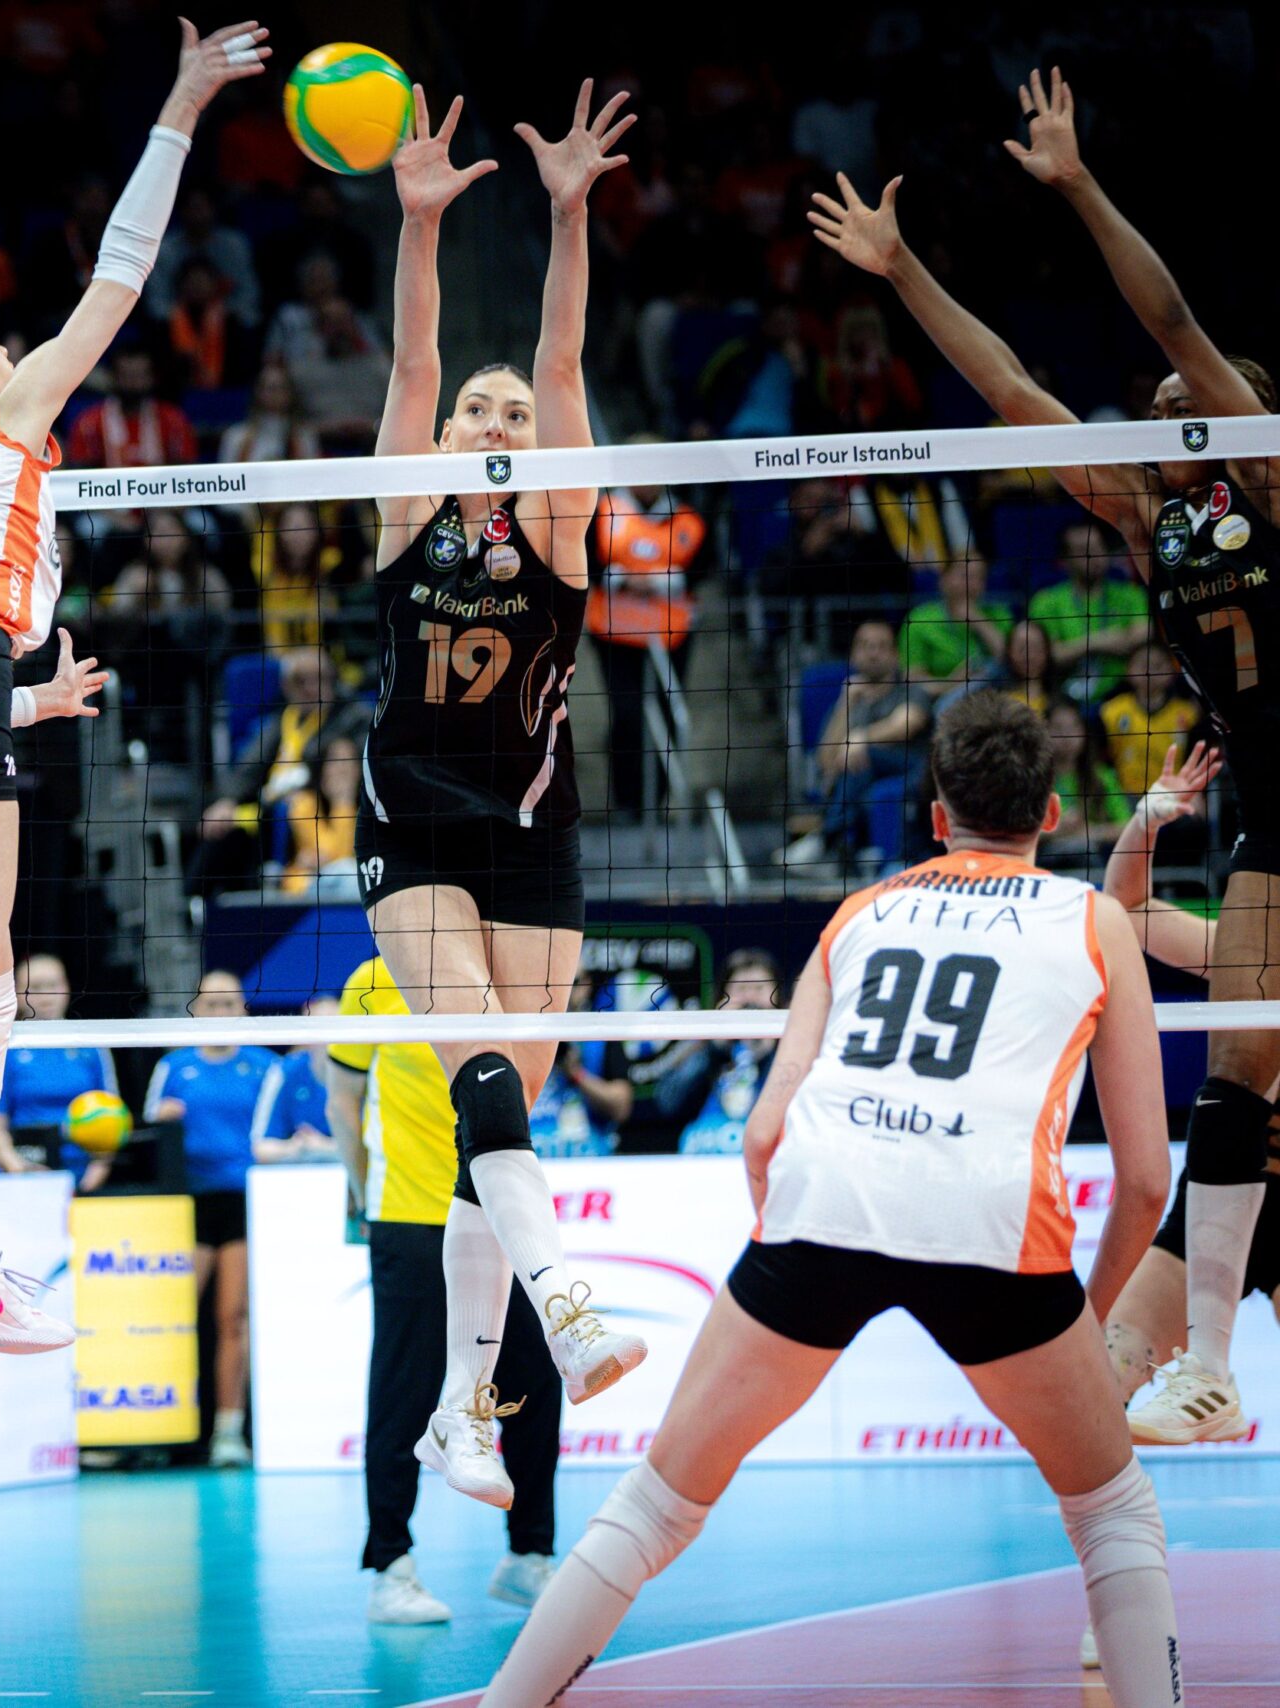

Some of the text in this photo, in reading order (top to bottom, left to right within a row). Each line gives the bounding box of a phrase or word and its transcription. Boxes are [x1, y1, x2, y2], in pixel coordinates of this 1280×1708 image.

[755, 441, 931, 468] Final Four Istanbul
[78, 474, 246, 498] Final Four Istanbul
[418, 620, 512, 704] 19
[1196, 606, 1259, 692] 7
[359, 856, 385, 892] 19
[839, 948, 1002, 1081] 99
[849, 1095, 933, 1136] Club
